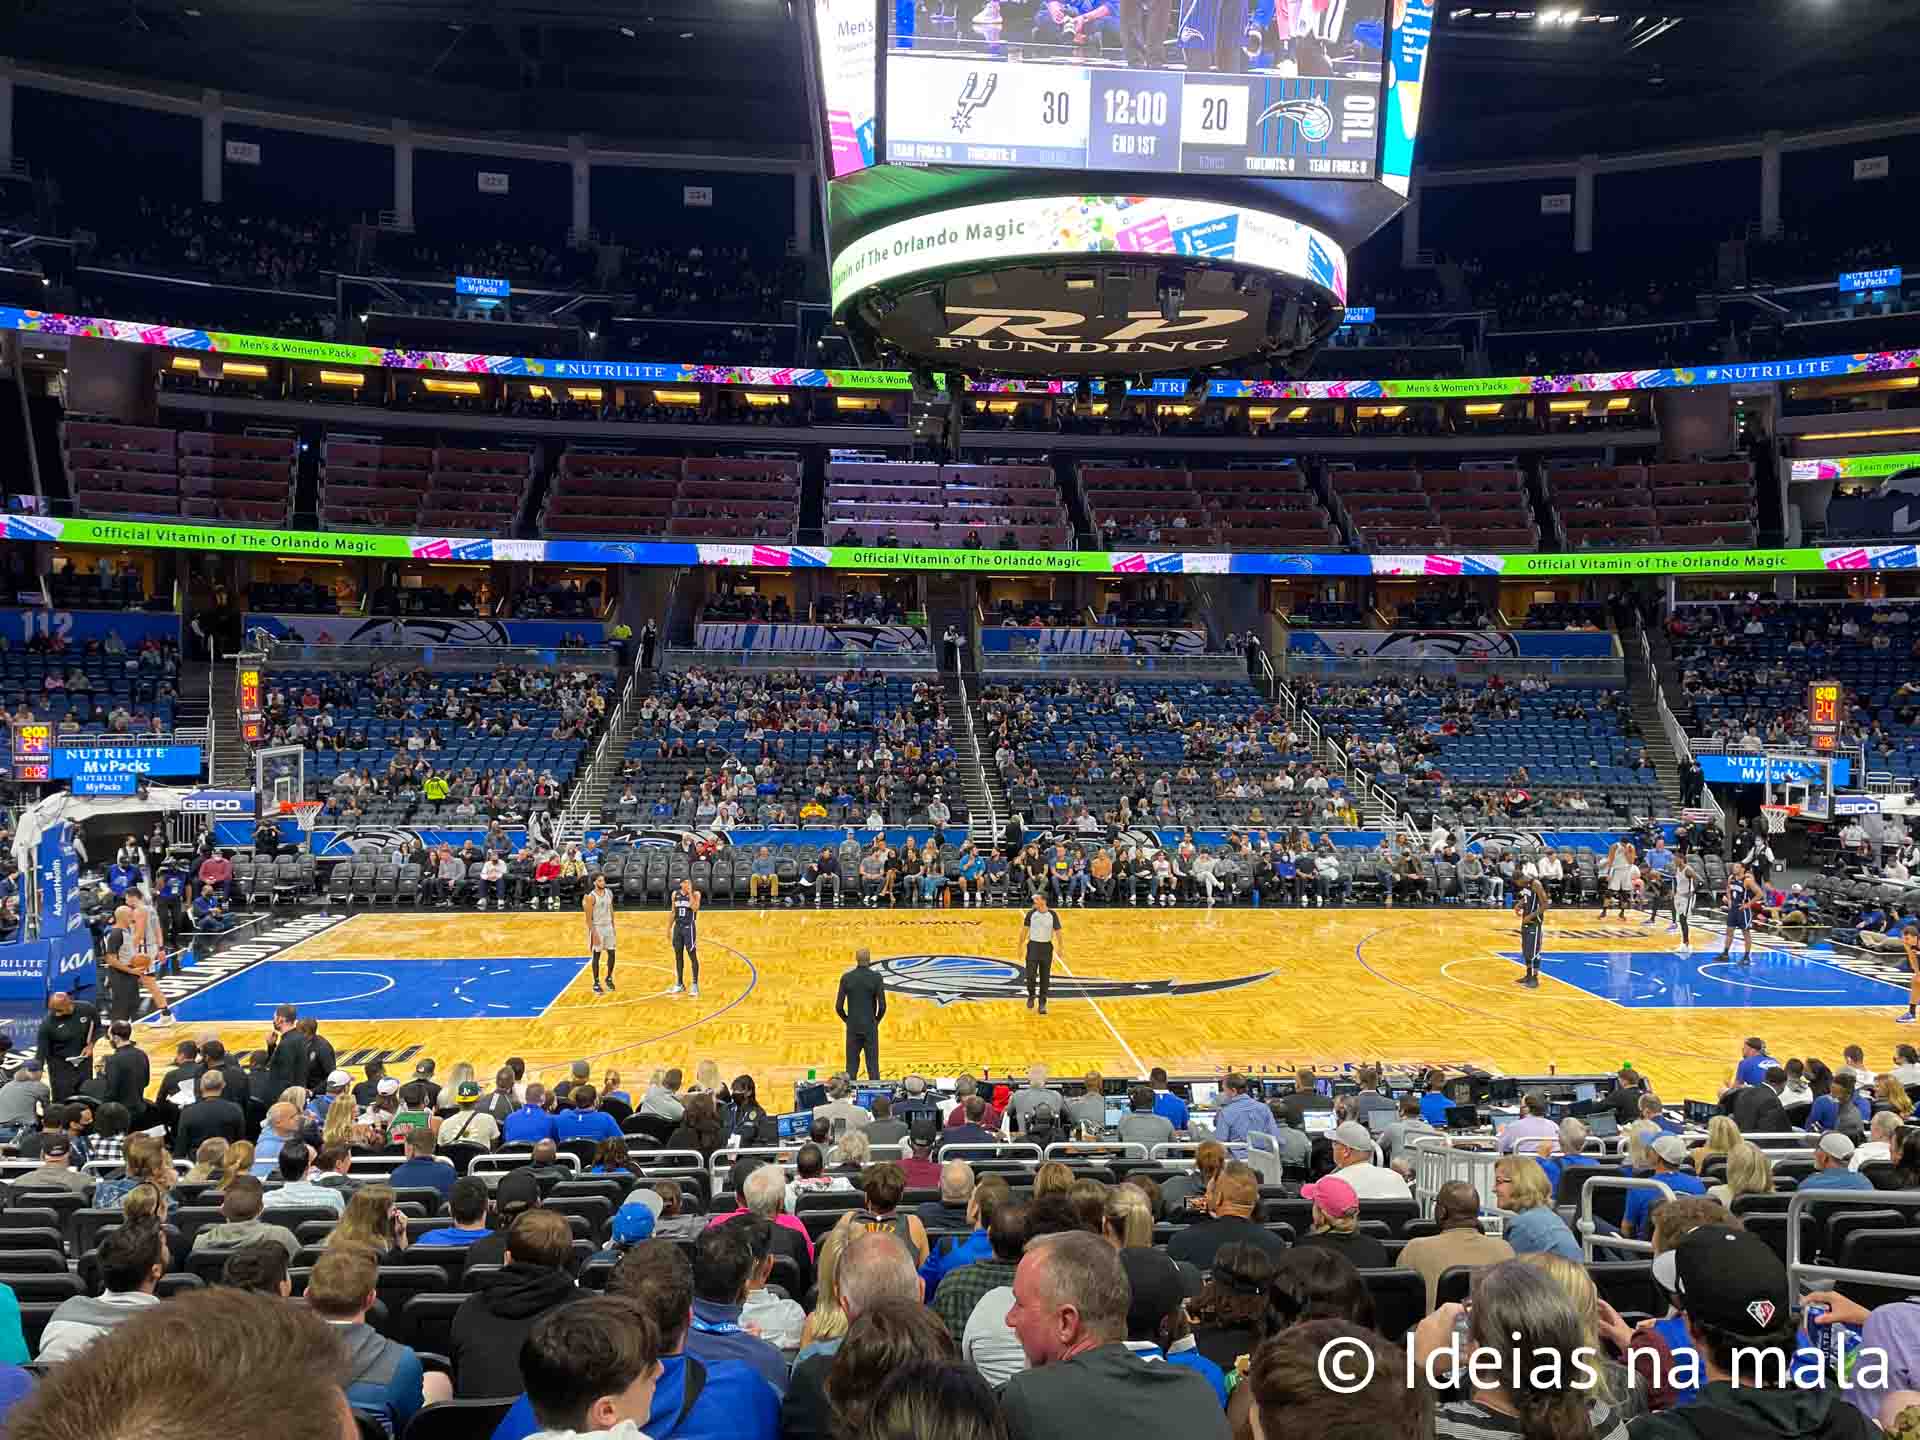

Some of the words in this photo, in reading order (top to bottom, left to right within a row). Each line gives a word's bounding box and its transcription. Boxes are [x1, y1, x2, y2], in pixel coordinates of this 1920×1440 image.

[838, 18, 874, 37] Men's
[1043, 91, 1069, 124] 30
[1103, 89, 1168, 126] 12:00
[1201, 98, 1228, 130] 20
[1342, 95, 1376, 143] ORL
[1112, 134, 1135, 153] END
[1137, 135, 1157, 155] 1ST
[856, 253, 865, 272] of
[868, 247, 888, 266] The
[893, 228, 958, 256] Orlando
[965, 218, 1025, 242] Magic
[1846, 269, 1896, 281] NUTRILITE
[1854, 278, 1888, 289] MyPacks
[945, 306, 1249, 340] RP
[240, 339, 269, 350] Men's
[271, 343, 280, 351] &
[281, 344, 326, 356] Women's
[329, 347, 356, 359] Packs
[934, 336, 1230, 353] FUNDING
[568, 364, 666, 377] NUTRILITE
[1721, 361, 1831, 379] NUTRILITE
[851, 375, 875, 384] Men's
[877, 376, 885, 384] &
[1407, 383, 1430, 392] Men's
[1433, 383, 1440, 392] &
[1440, 382, 1480, 392] Women's
[1482, 382, 1508, 391] Packs
[92, 527, 150, 541] Official
[156, 531, 215, 545] Vitamin
[221, 534, 236, 545] of
[242, 535, 266, 546] The
[271, 536, 330, 549] Orlando
[335, 539, 377, 552] Magic
[854, 552, 899, 564] Official
[902, 553, 950, 565] Vitamin
[954, 554, 966, 565] of
[970, 555, 990, 566] The
[994, 555, 1042, 567] Orlando
[1047, 556, 1081, 568] Magic
[1527, 559, 1575, 570] Official
[1580, 557, 1631, 569] Vitamin
[1636, 557, 1650, 569] of
[1655, 557, 1678, 569] The
[1682, 556, 1739, 568] Orlando
[1744, 556, 1787, 568] Magic
[21, 612, 73, 643] 112
[1816, 687, 1836, 701] 12:00
[1816, 701, 1835, 721] 24
[24, 737, 44, 752] 24
[66, 747, 167, 760] NUTRILITE
[84, 760, 151, 773] MyPacks
[76, 774, 131, 783] NUTRILITE
[85, 783, 121, 793] MyPacks
[183, 798, 241, 811] GEICO
